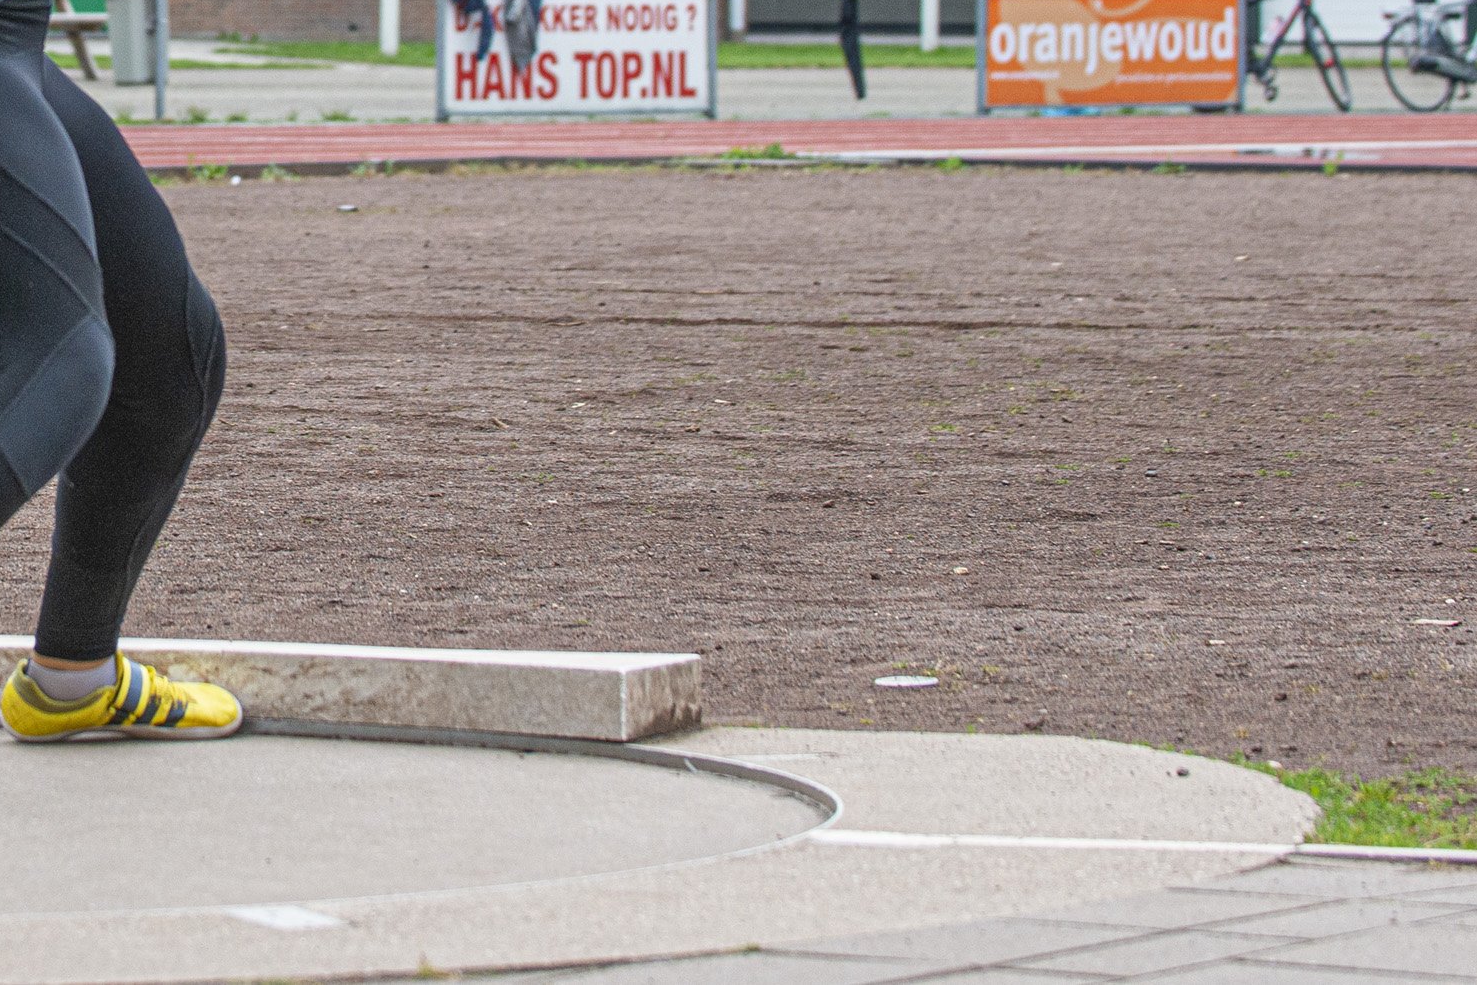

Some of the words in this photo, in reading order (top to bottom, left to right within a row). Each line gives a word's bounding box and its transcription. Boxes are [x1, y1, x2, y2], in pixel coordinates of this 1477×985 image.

[606, 3, 678, 32] NODIG
[989, 6, 1235, 76] oranjewoud
[454, 50, 559, 101] HANS
[572, 50, 698, 101] TOP.NL
